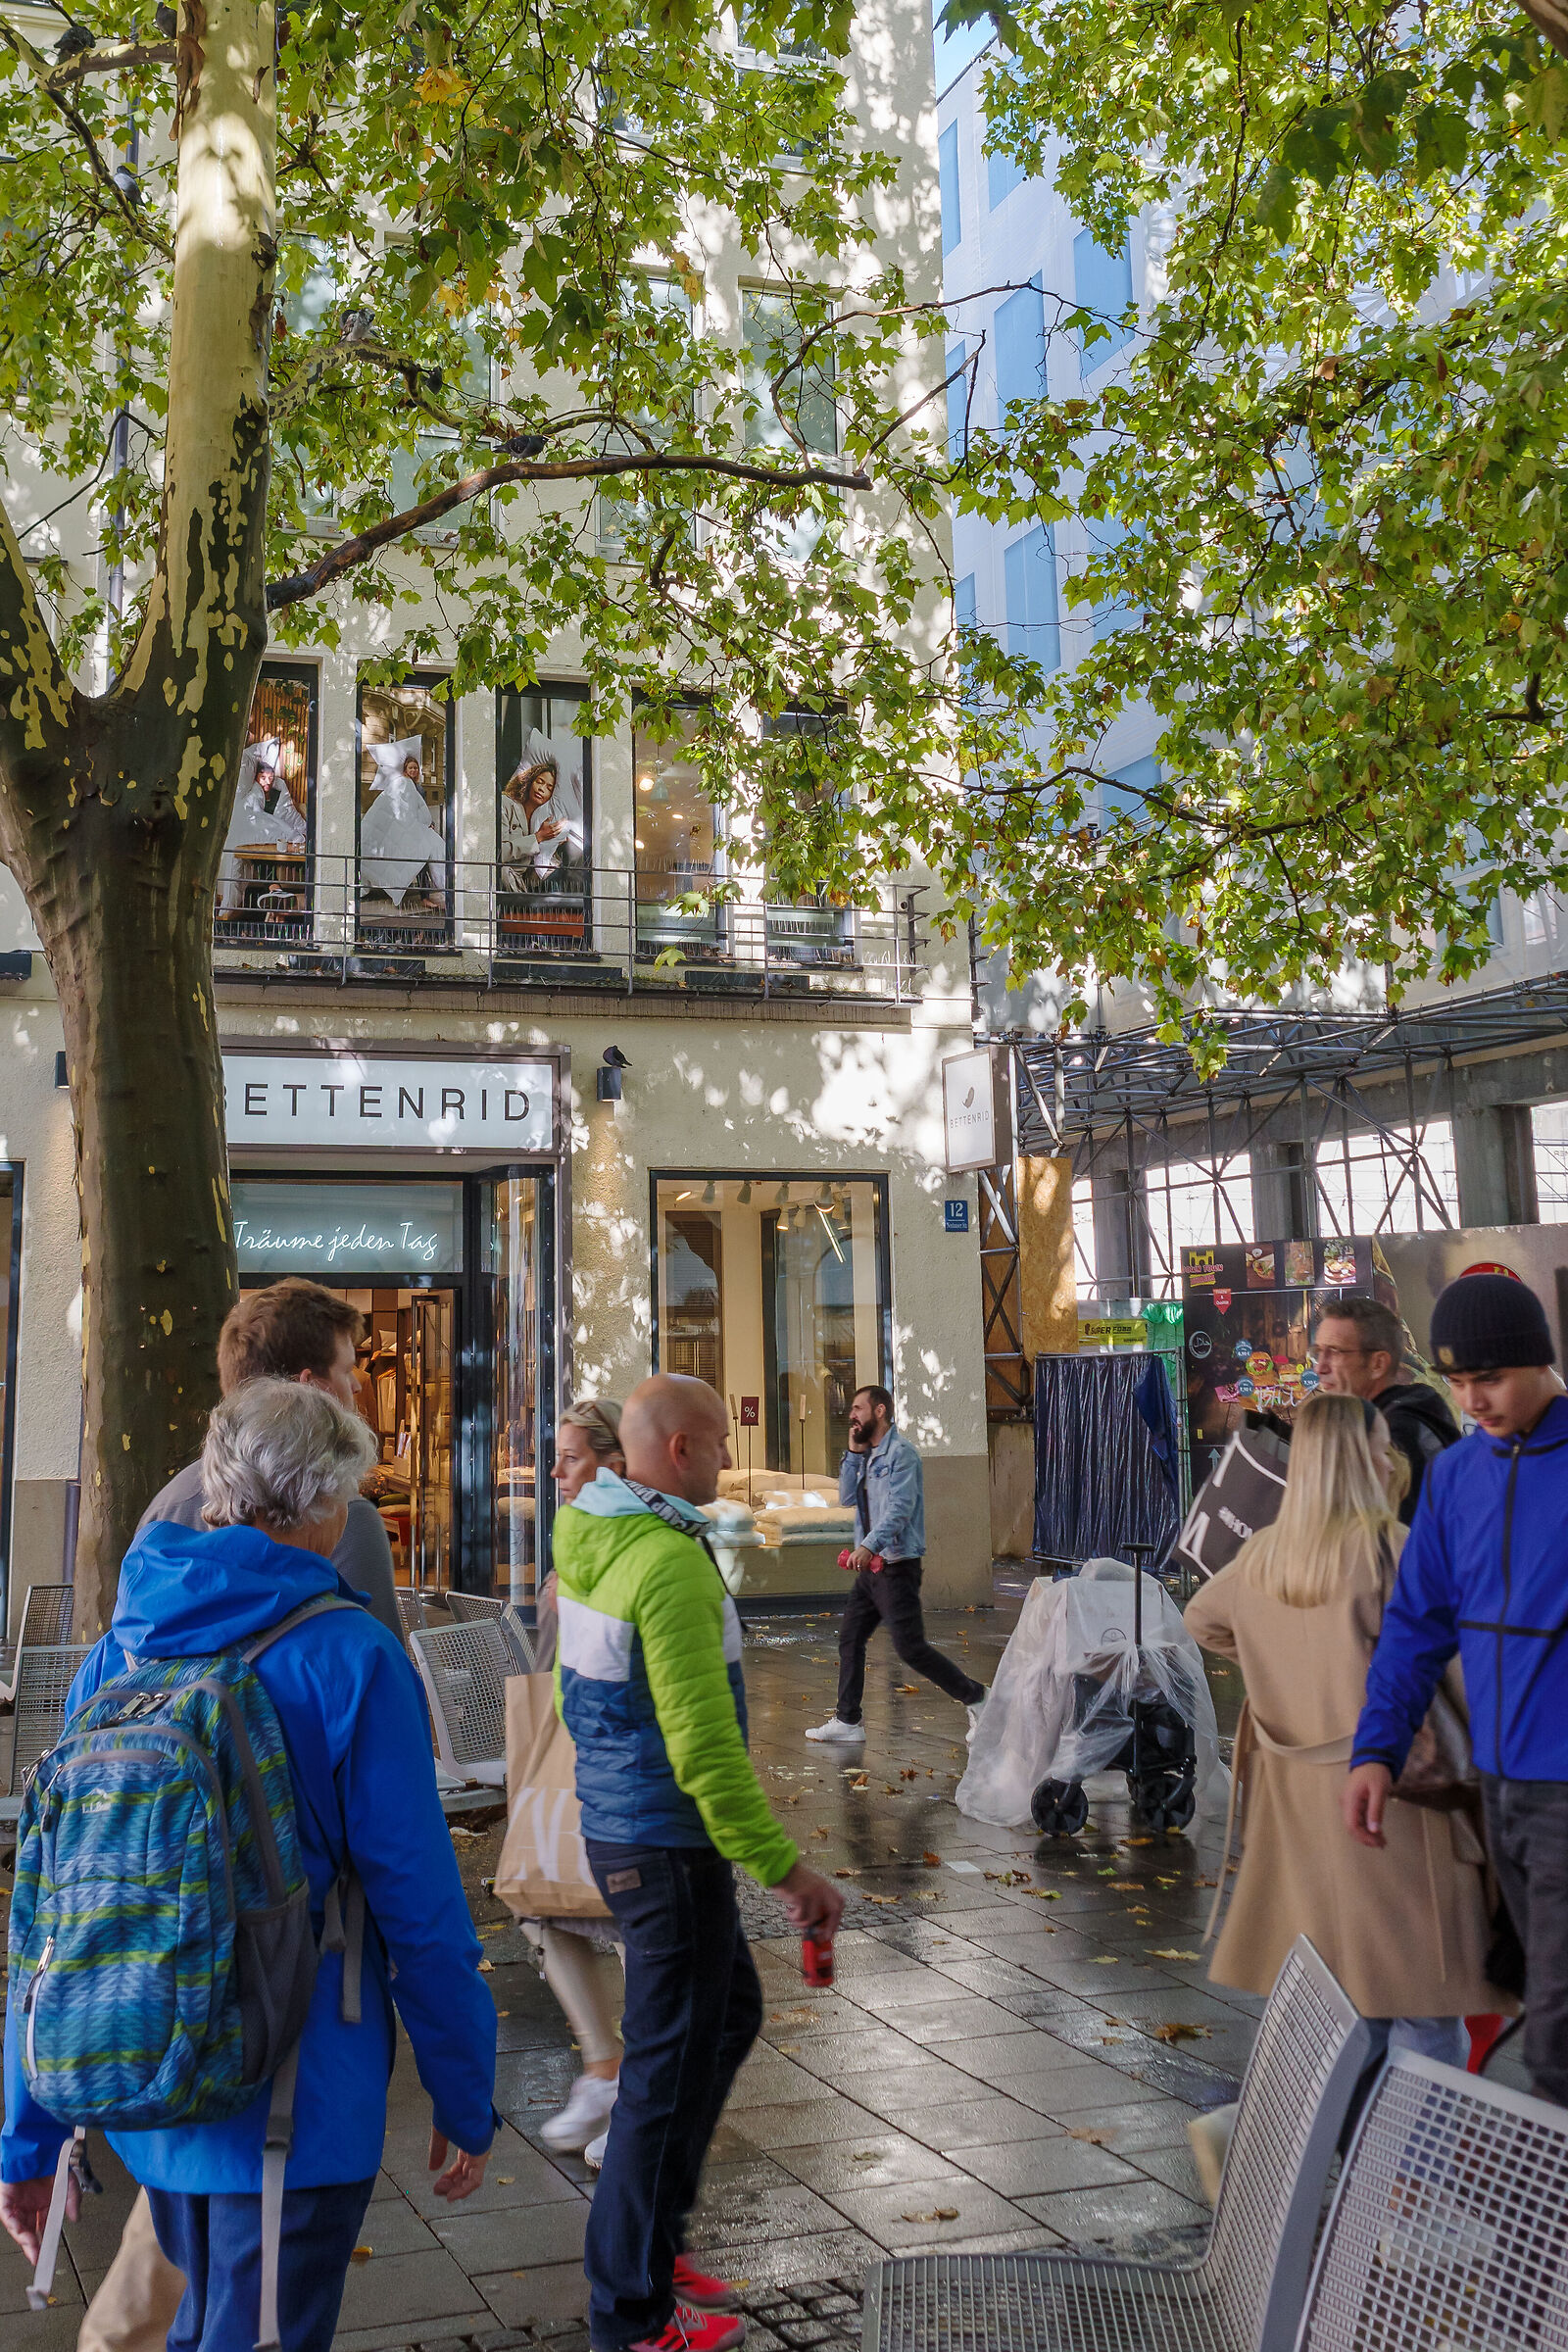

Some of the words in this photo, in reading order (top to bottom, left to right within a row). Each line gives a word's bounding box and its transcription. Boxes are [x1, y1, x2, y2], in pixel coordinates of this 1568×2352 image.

[224, 1083, 531, 1121] ETTENRID
[950, 1110, 990, 1129] BETTENRID
[950, 1201, 963, 1217] 12
[233, 1218, 323, 1250] Träume
[327, 1223, 395, 1262] jeden
[399, 1220, 439, 1261] Tag
